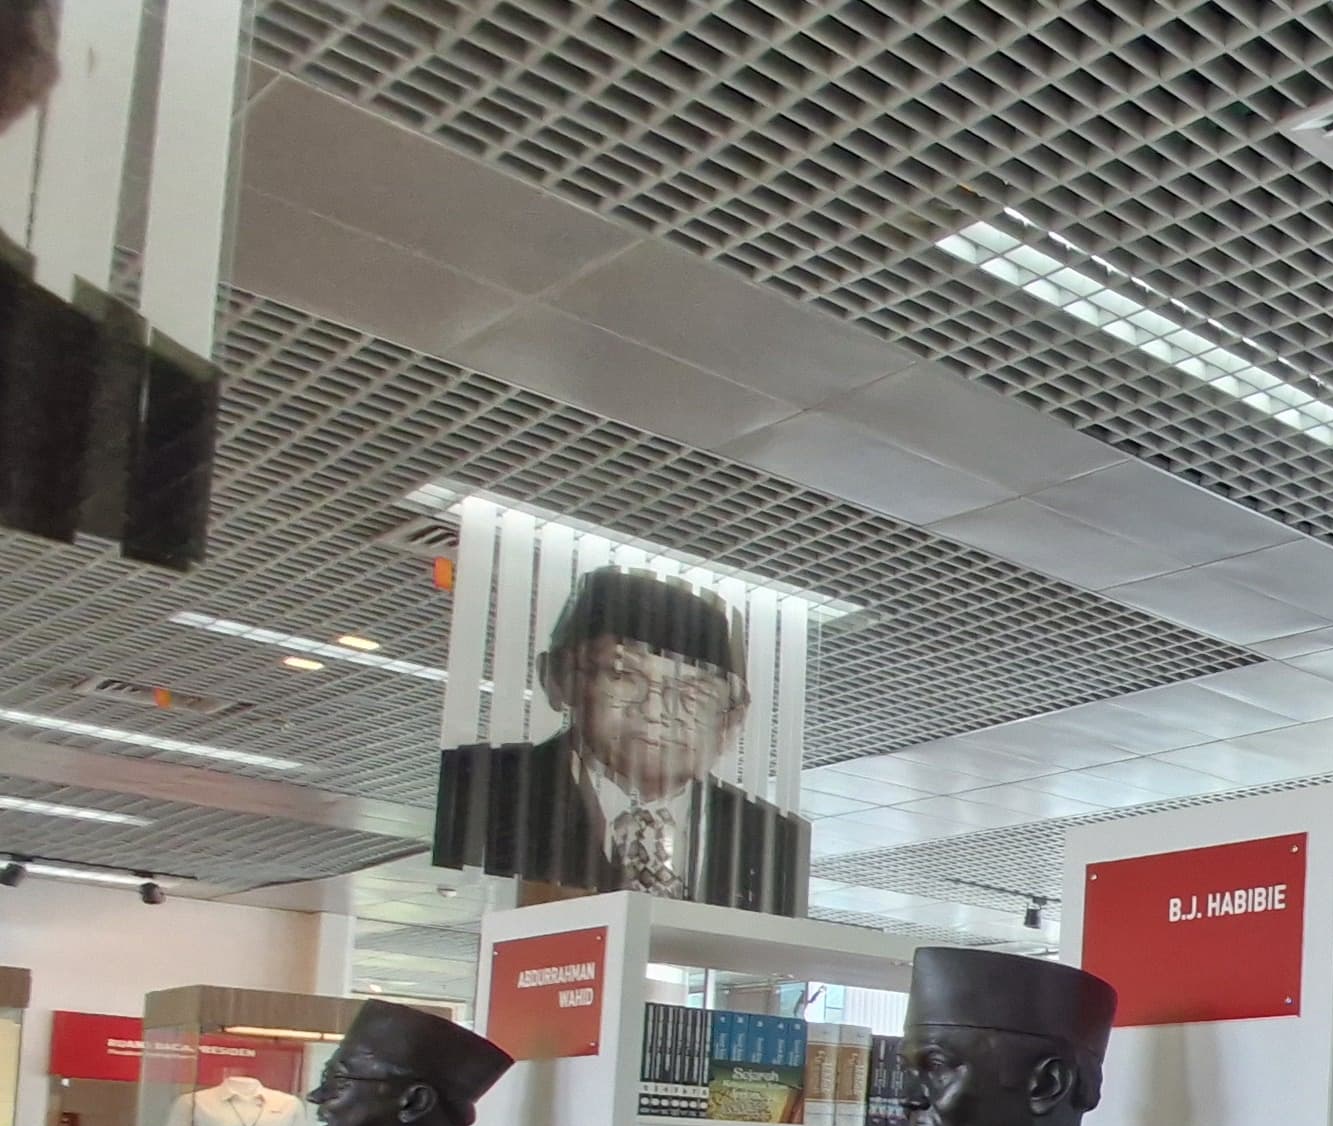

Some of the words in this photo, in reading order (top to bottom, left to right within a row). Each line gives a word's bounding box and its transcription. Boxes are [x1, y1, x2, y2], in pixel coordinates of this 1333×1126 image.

[1168, 895, 1202, 923] B.J.
[1207, 883, 1288, 918] HABIBIE
[516, 961, 597, 989] ABDURRAHMAN
[558, 987, 594, 1008] WAHID
